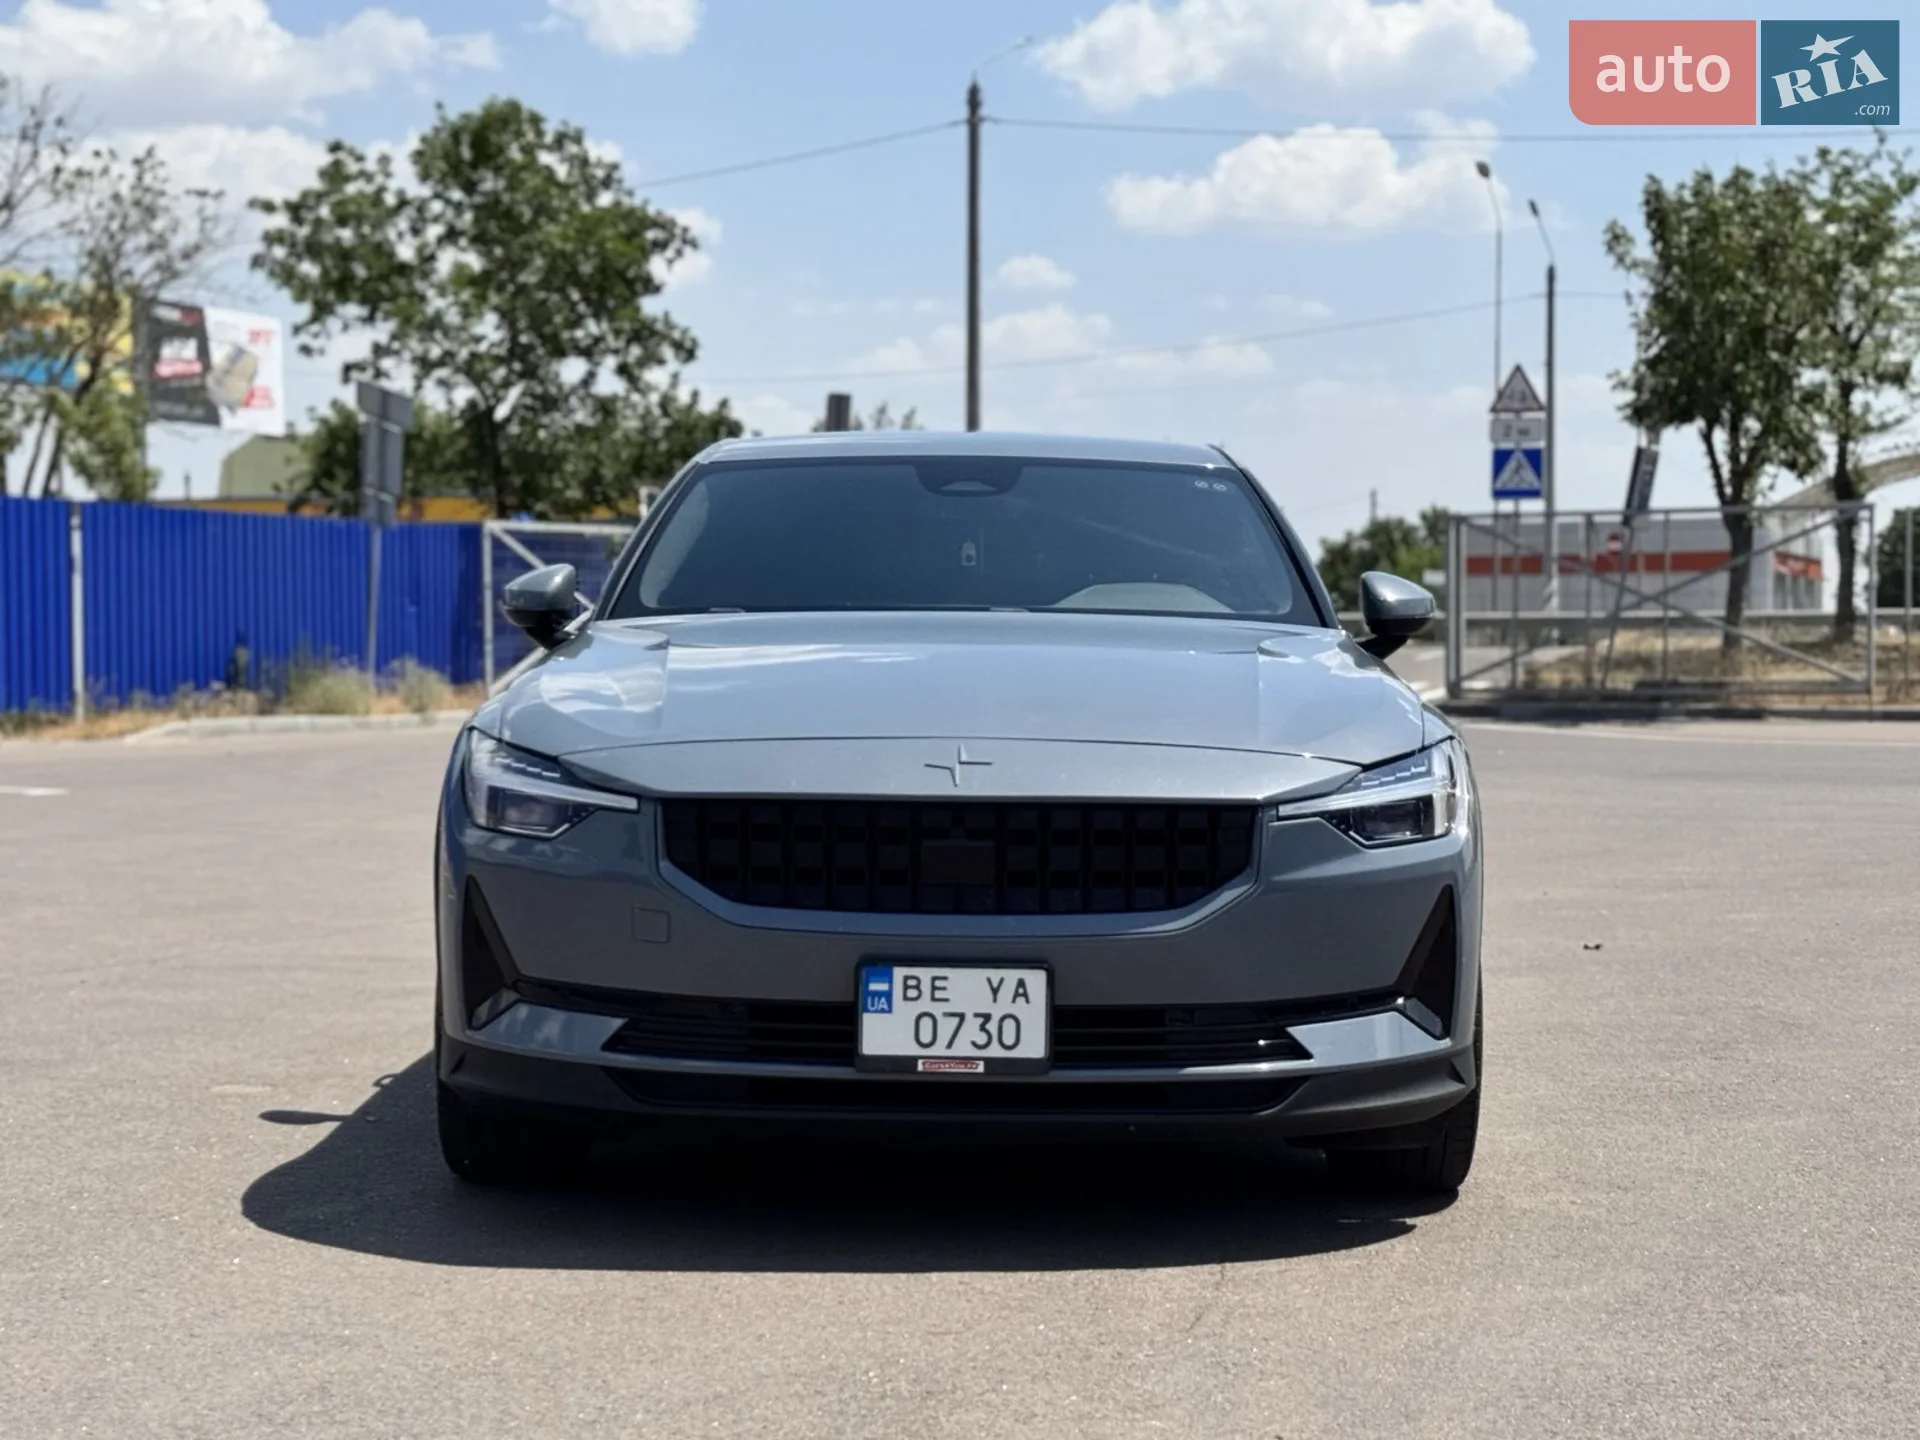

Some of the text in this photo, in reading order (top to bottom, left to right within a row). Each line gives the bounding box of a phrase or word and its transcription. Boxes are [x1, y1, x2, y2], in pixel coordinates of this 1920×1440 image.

[867, 997, 889, 1011] UA
[902, 975, 1030, 1004] BE YA
[914, 1011, 1021, 1051] 0730
